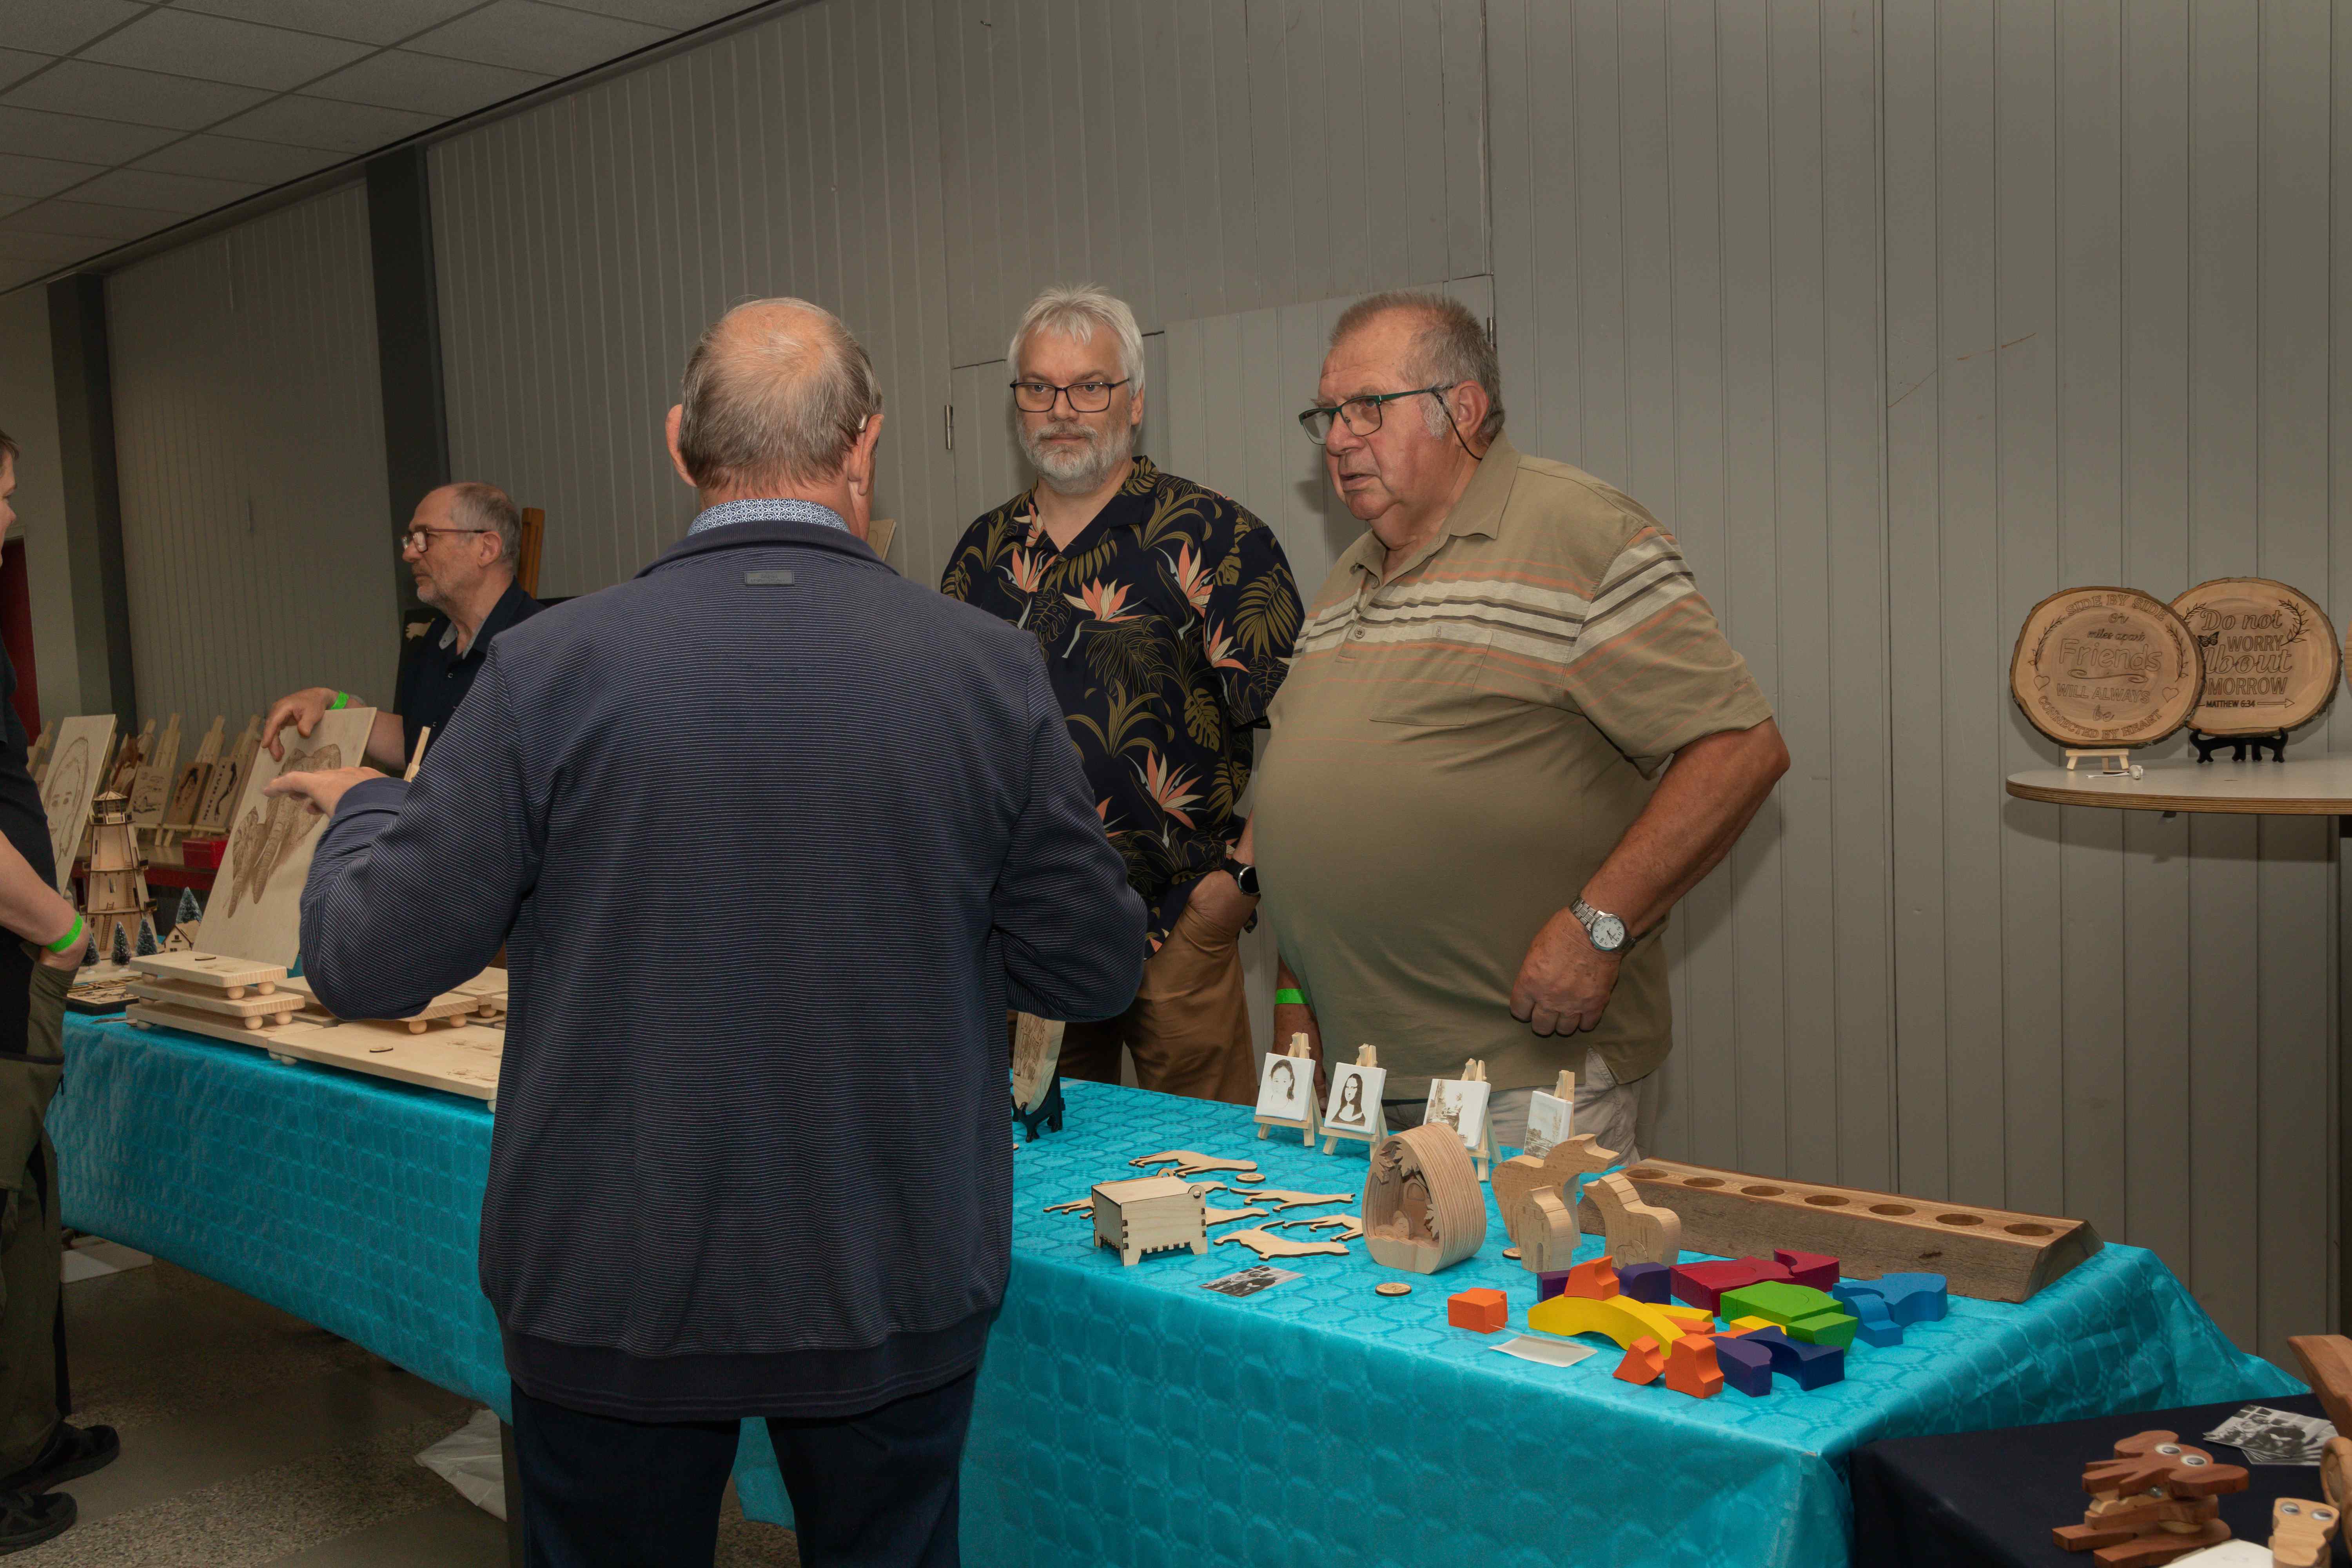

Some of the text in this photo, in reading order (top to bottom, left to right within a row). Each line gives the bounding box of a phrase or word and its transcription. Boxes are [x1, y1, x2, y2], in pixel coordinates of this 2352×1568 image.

[2066, 595, 2168, 621] SIDE BY SIDE
[2108, 613, 2129, 624] or
[2200, 609, 2282, 630] Do not
[2087, 628, 2145, 645] miles apart
[2227, 635, 2283, 652] WORRY
[2059, 639, 2162, 671] Friends
[2057, 683, 2150, 704] WILL ALWAYS
[2038, 696, 2162, 739] CONNECTED BY HEART
[2092, 704, 2114, 722] be
